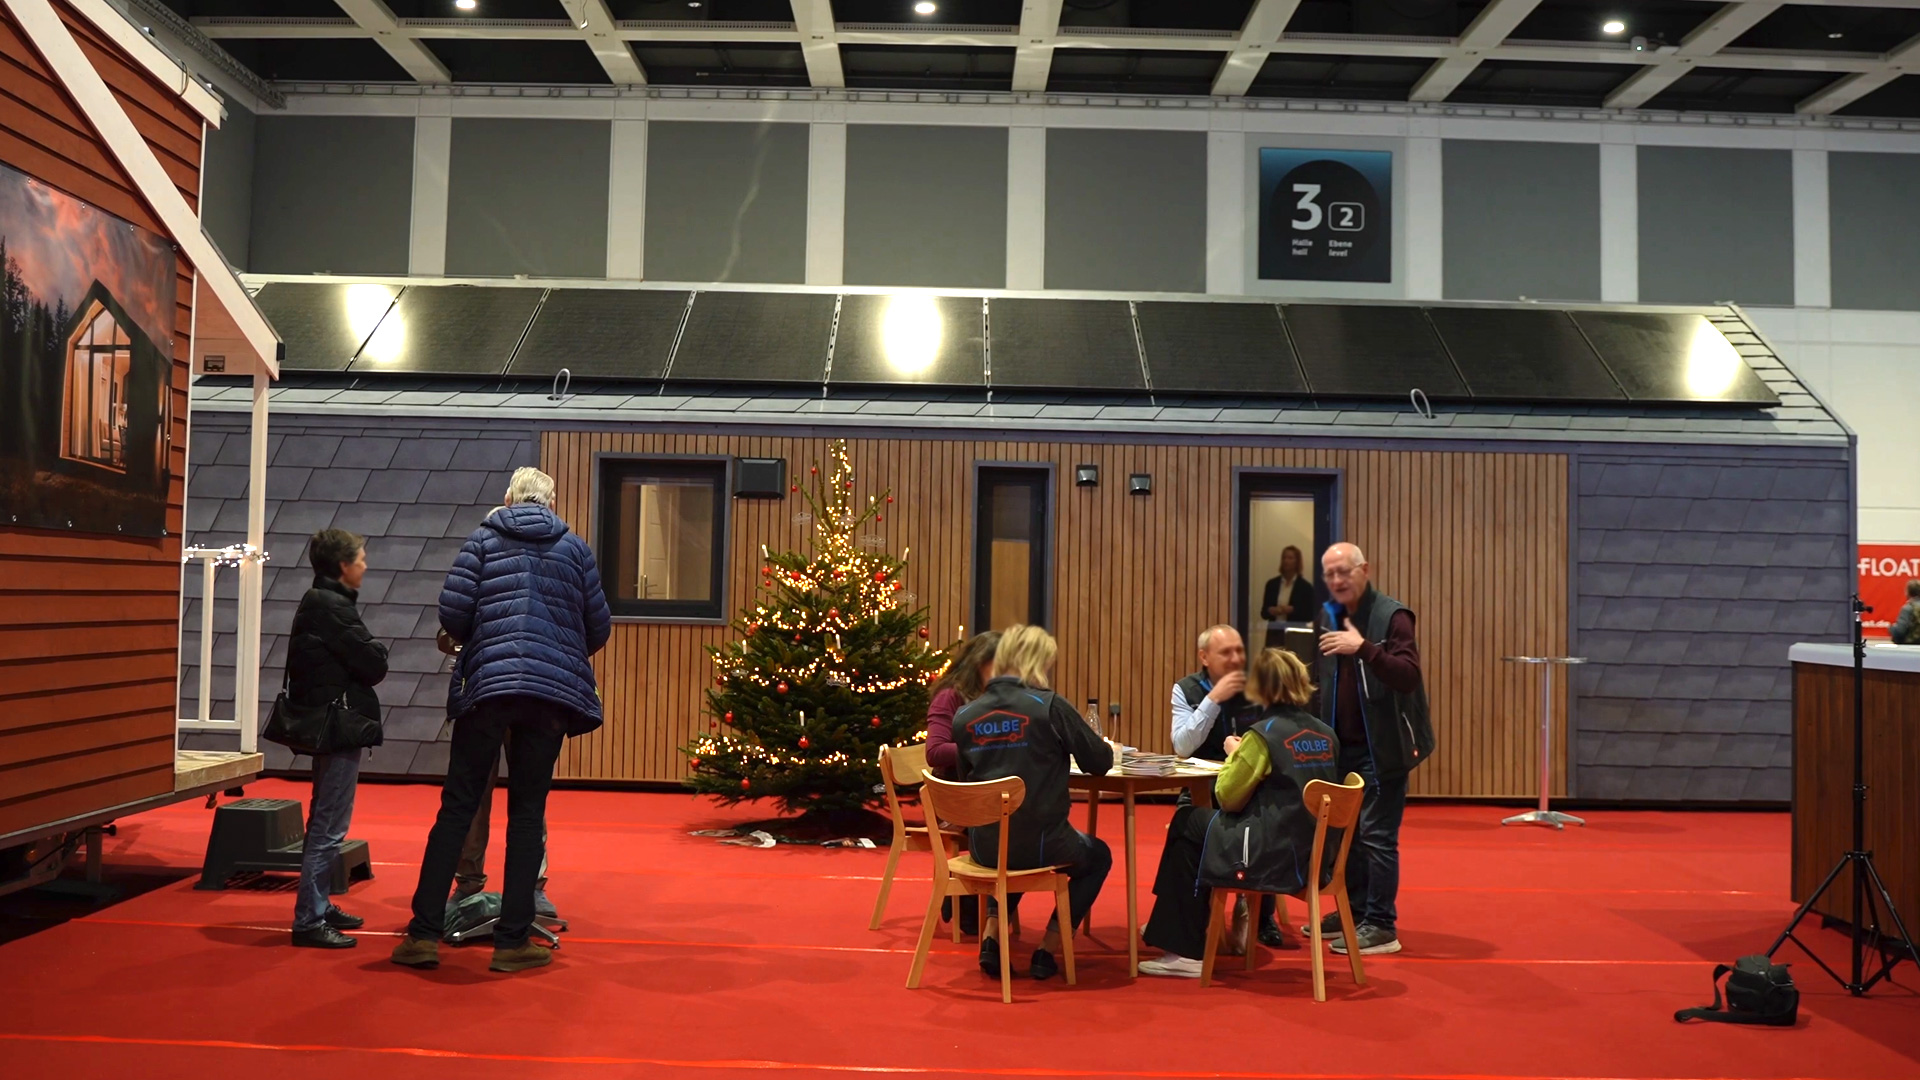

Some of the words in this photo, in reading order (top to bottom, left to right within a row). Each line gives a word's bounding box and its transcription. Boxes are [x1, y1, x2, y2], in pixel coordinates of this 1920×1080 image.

[1291, 183, 1323, 231] 3
[1339, 206, 1354, 227] 2
[1292, 239, 1313, 247] Halle
[1328, 240, 1353, 248] Ebene
[1292, 248, 1308, 256] hall
[1328, 249, 1348, 257] level
[974, 719, 1020, 736] KOLBE
[1293, 740, 1329, 752] KOLBE
